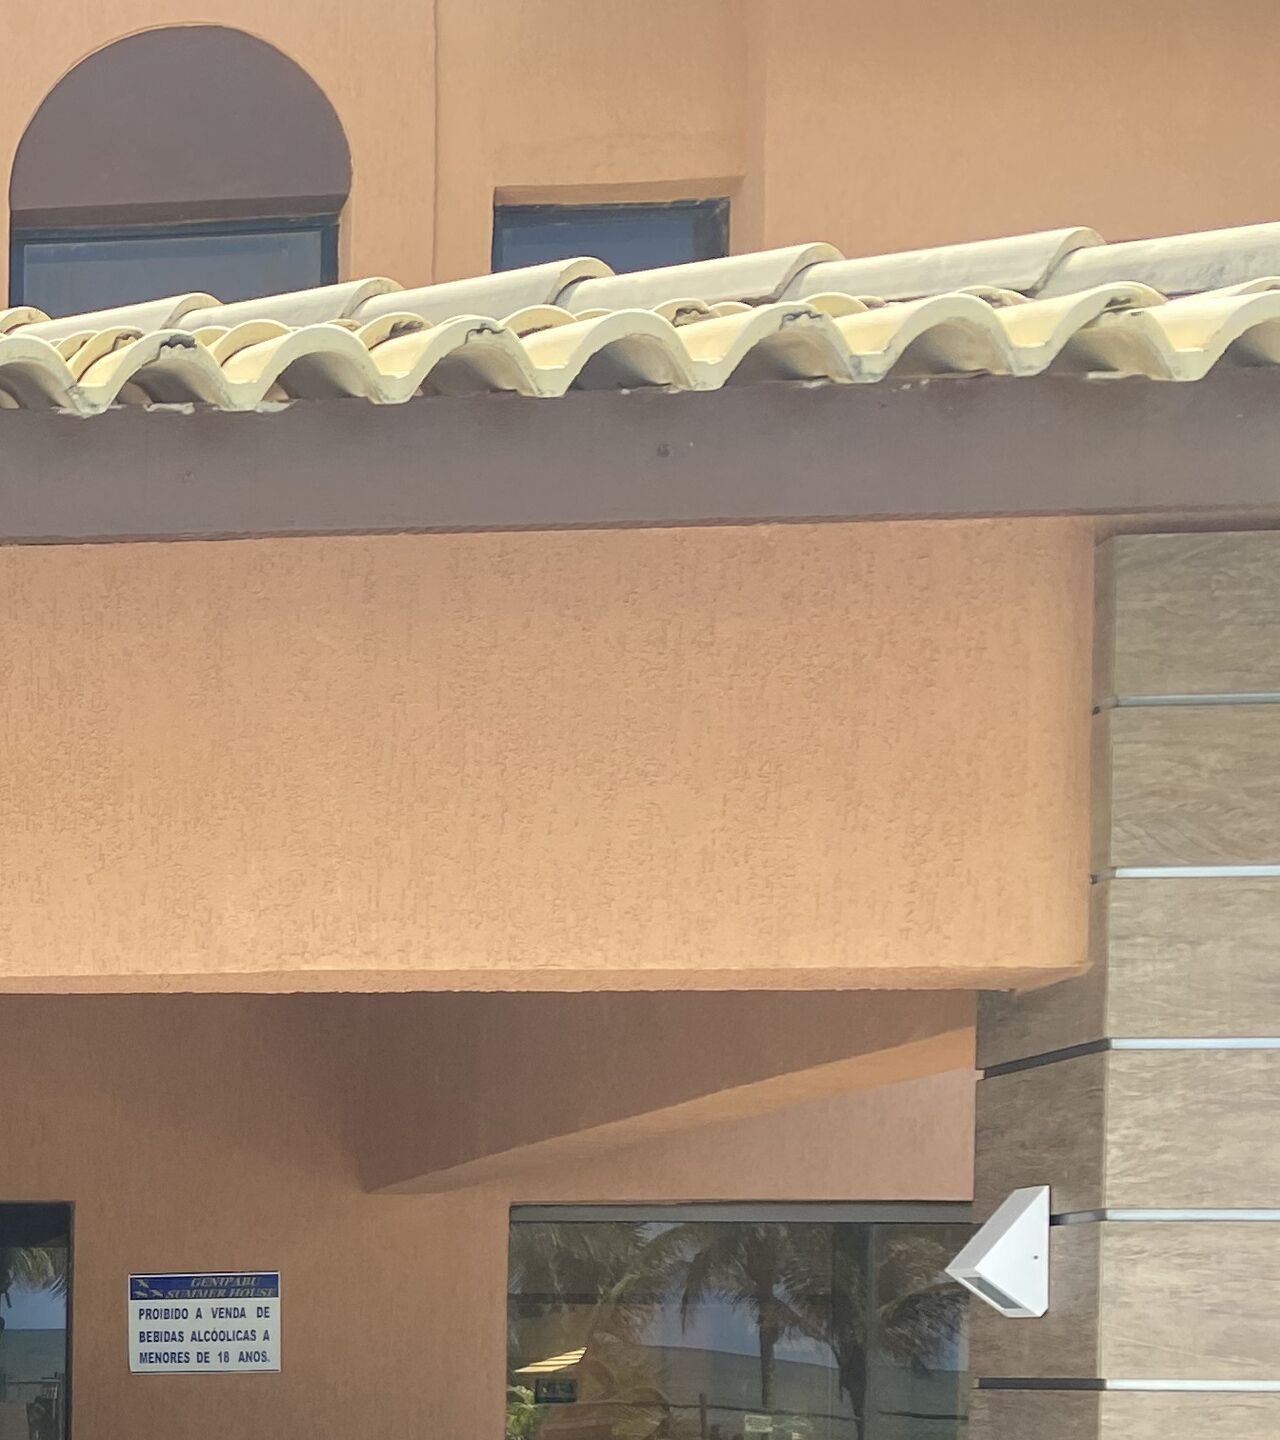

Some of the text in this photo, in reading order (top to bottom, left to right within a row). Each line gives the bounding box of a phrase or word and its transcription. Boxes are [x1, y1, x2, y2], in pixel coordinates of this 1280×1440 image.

[166, 1287, 274, 1298] SUMMER HOUSE
[139, 1306, 270, 1320] PROIBIDO A VENDA DE
[139, 1328, 270, 1343] BEBIDAS ALCÓOLICAS A
[139, 1351, 271, 1364] MENORES DE 18 ANOS.
